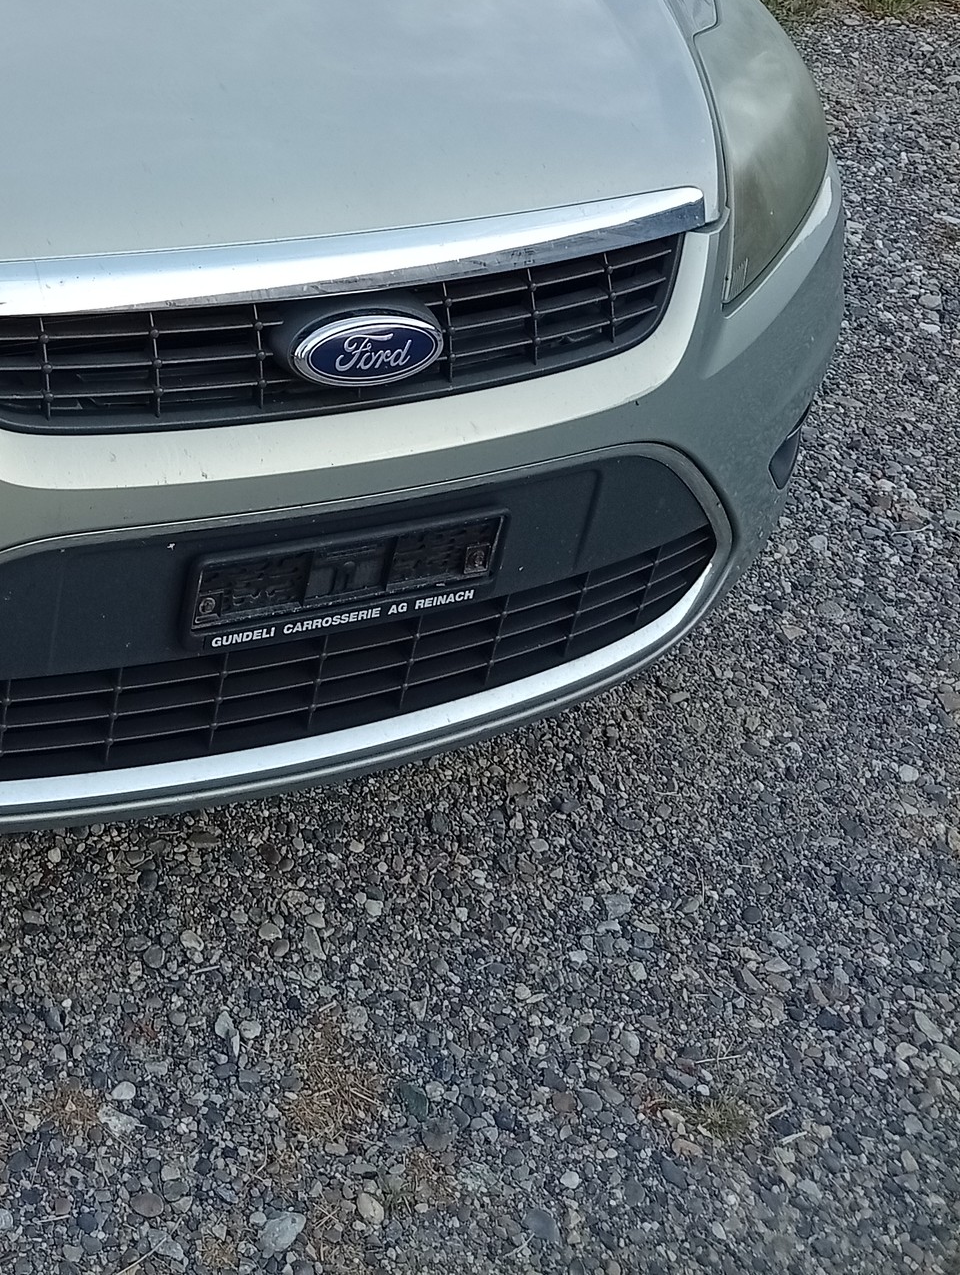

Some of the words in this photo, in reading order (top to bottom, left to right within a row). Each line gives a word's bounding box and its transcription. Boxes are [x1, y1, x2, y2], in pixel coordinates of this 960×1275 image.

[335, 333, 412, 371] Ford
[211, 627, 275, 647] GUNDELI
[283, 607, 381, 633] CARROSSERIE
[388, 602, 408, 615] AG
[414, 589, 475, 610] REINACH
